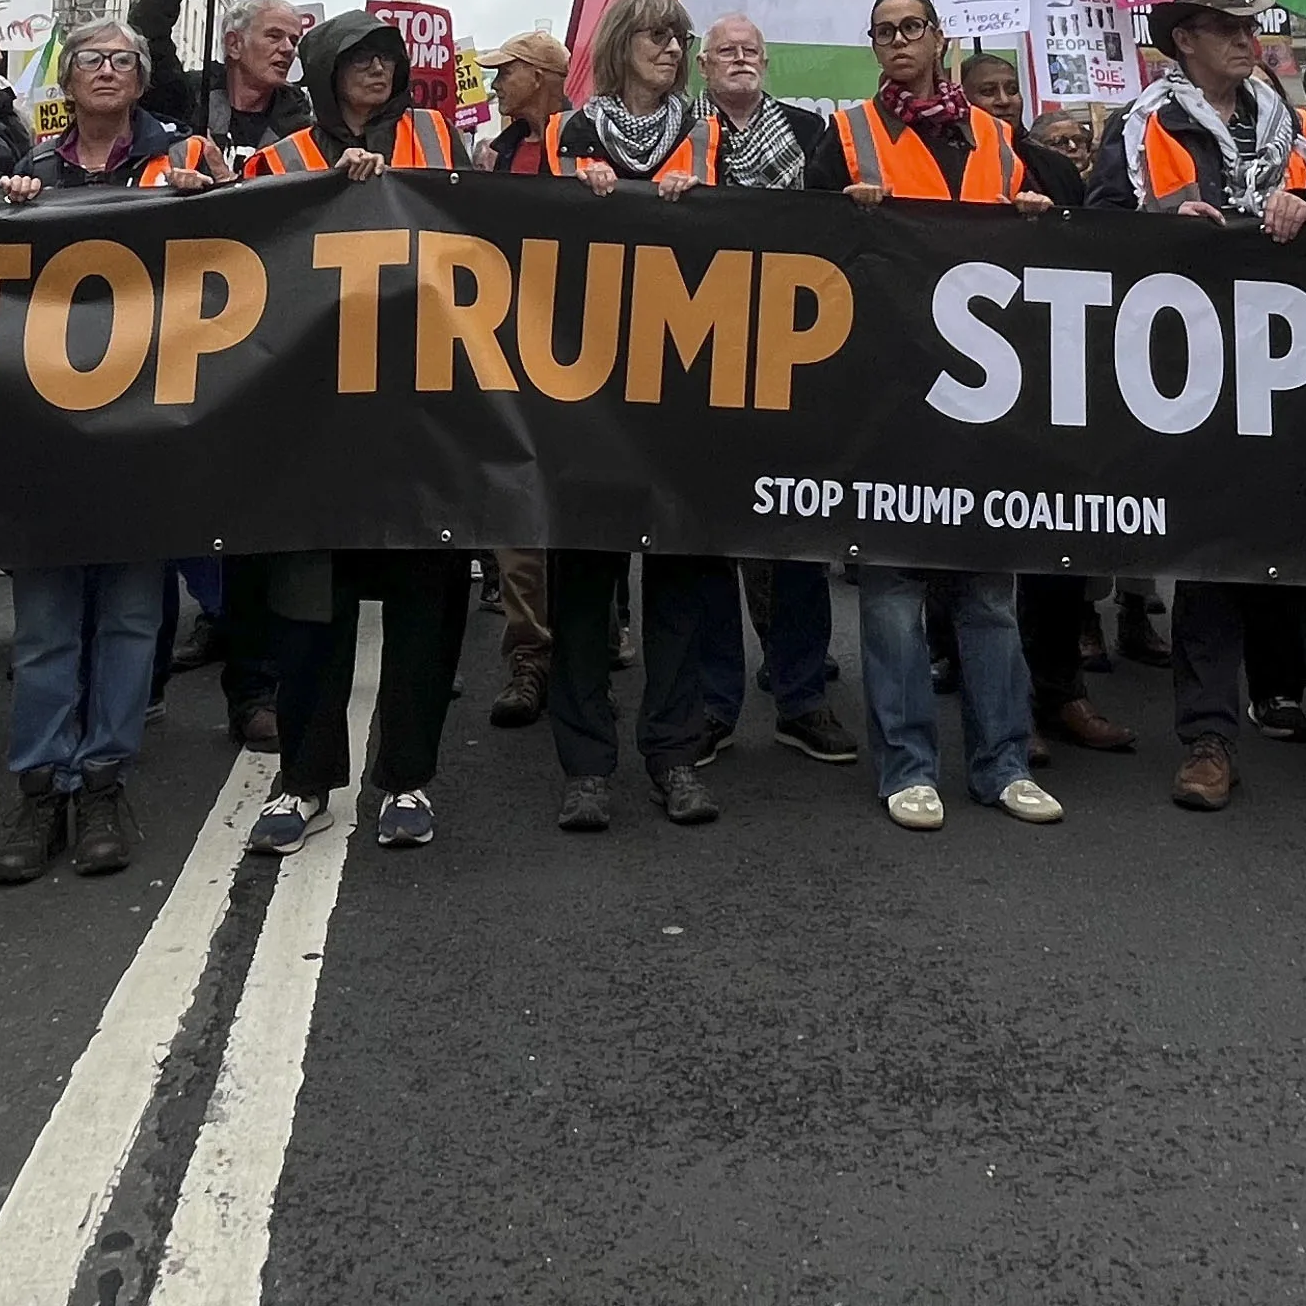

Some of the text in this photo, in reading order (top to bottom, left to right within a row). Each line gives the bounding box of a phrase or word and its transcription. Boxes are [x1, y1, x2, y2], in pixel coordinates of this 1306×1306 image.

[375, 9, 448, 44] STOP
[406, 43, 450, 70] UMP
[1046, 38, 1105, 52] PEOPLE
[39, 104, 59, 116] NO
[40, 115, 70, 131] RACI
[312, 228, 855, 411] TRUMP
[752, 475, 1167, 536] STOP TRUMP COALITION
